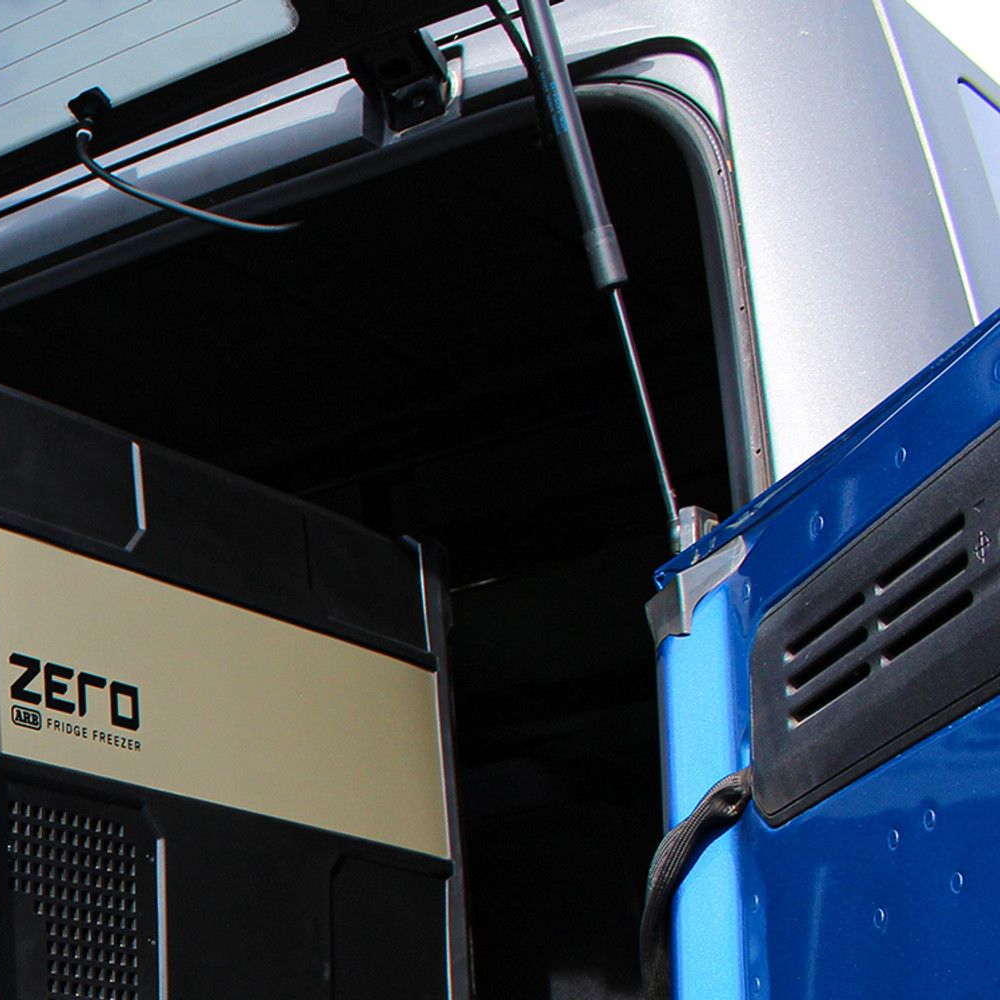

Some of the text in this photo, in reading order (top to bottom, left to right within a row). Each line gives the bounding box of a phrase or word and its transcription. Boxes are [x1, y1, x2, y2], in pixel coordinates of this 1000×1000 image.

[9, 652, 140, 732] ZERO
[13, 709, 142, 752] ARB FRIDGE FREEZER
